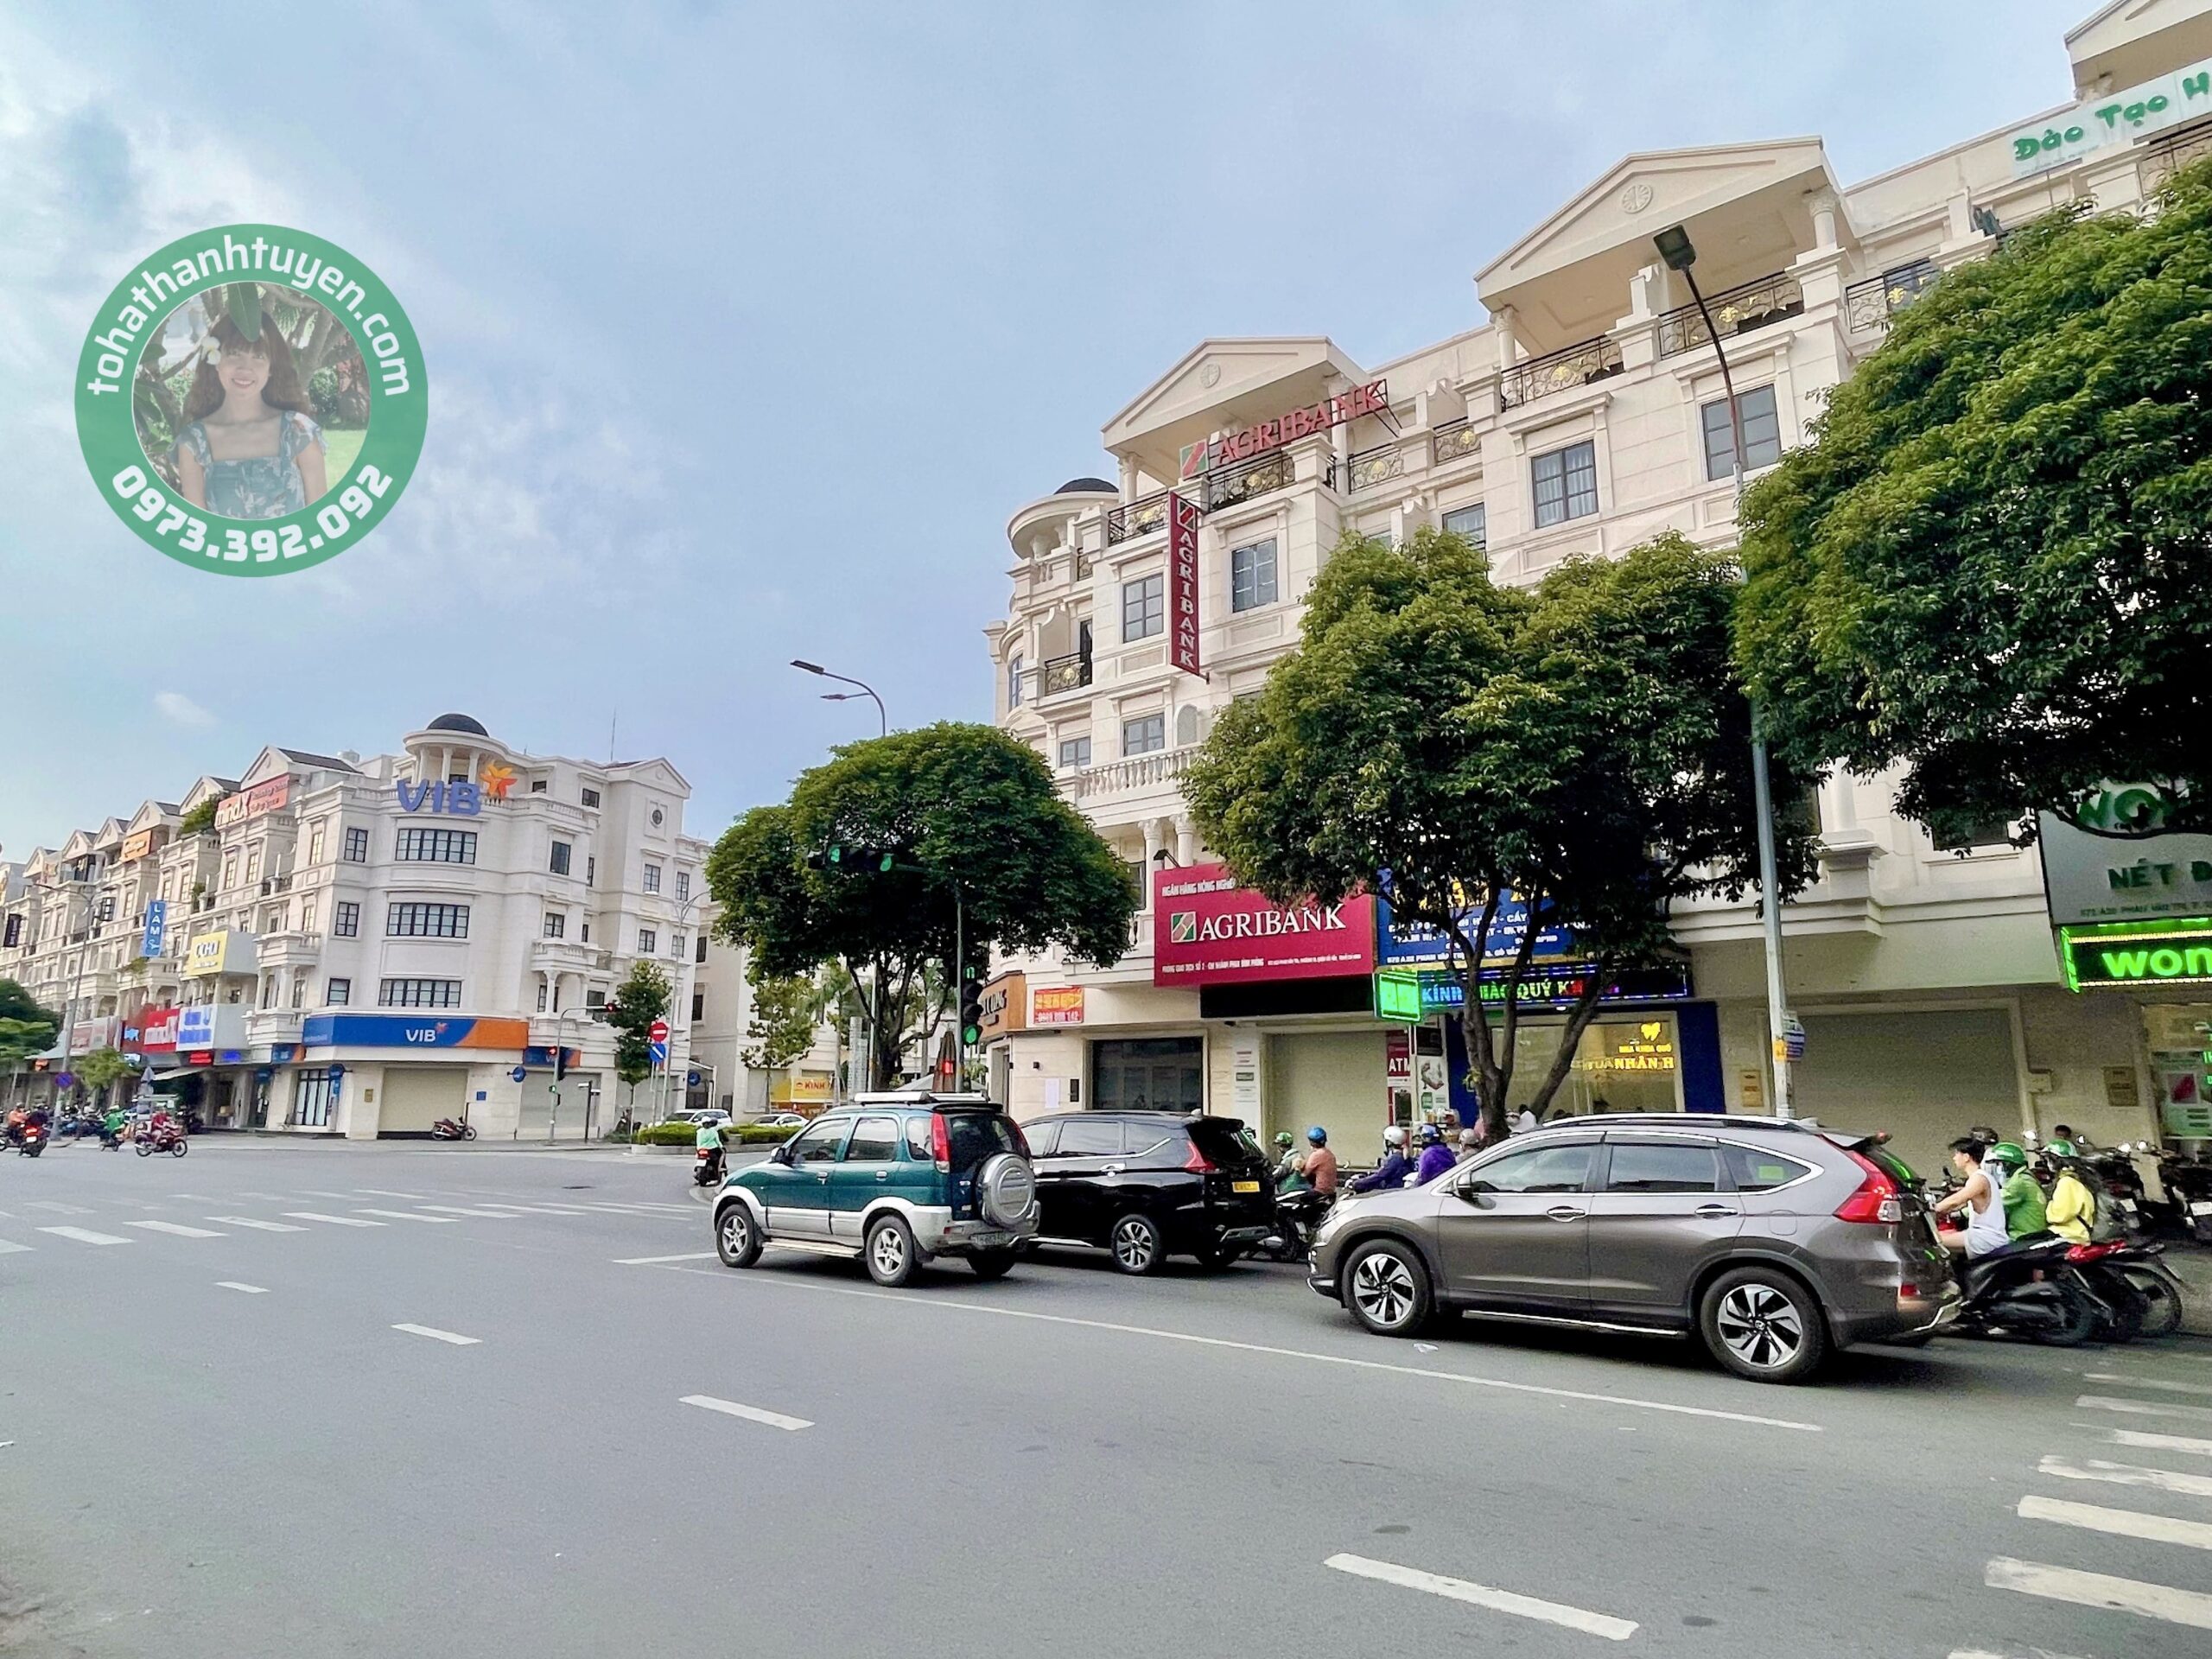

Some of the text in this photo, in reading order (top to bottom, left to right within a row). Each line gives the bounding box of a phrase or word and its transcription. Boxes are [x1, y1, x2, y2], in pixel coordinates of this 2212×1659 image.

[2094, 94, 2169, 129] Tạo
[1218, 380, 1387, 466] AGRIBANK
[1177, 530, 1197, 670] AGRIBANK
[397, 779, 481, 816] VIB
[1197, 903, 1346, 942] AGRIBANK
[2101, 947, 2212, 977] won
[1516, 978, 1552, 1000] QUÝ
[405, 1028, 436, 1042] VIB
